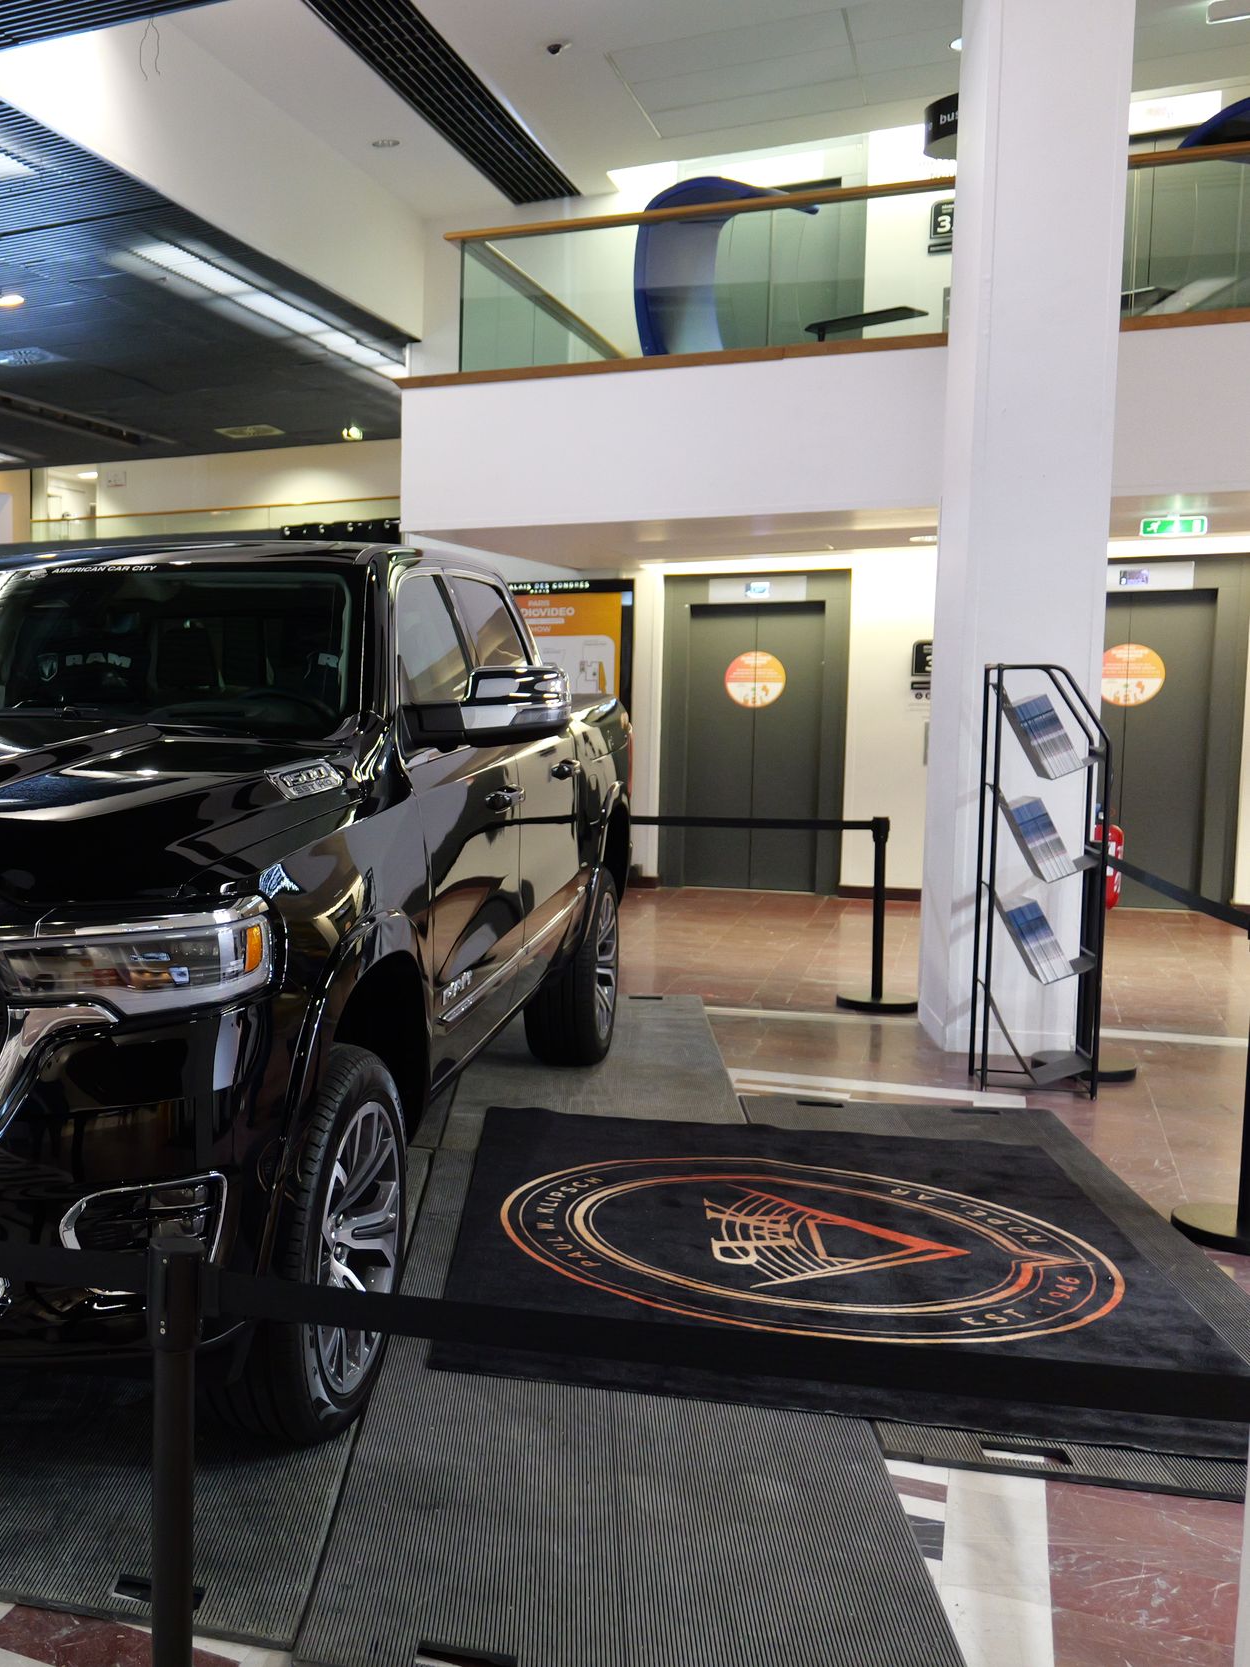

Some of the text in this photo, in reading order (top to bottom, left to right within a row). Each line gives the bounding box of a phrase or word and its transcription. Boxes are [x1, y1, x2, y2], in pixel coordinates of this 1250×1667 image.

[51, 566, 106, 574] AMERICAN
[65, 652, 132, 668] RAM
[536, 1176, 604, 1214] KLIPSCH
[890, 1187, 938, 1201] AR
[546, 1235, 603, 1267] PAUL
[1038, 1274, 1081, 1307] 1946
